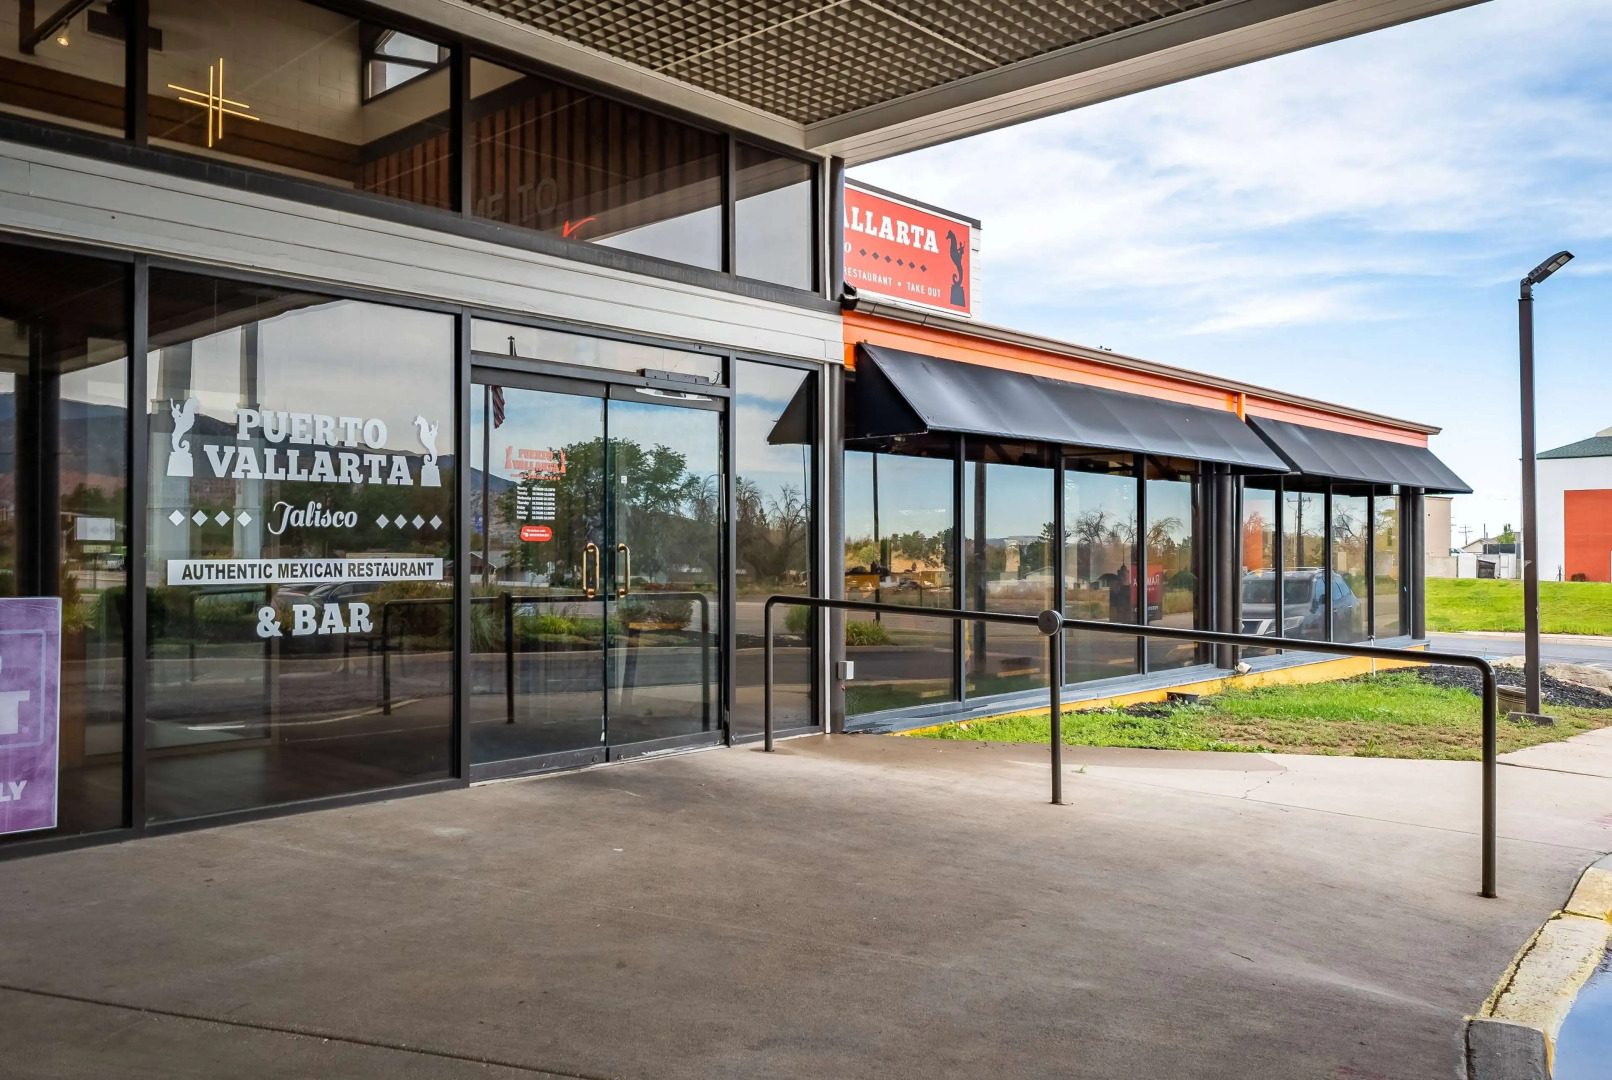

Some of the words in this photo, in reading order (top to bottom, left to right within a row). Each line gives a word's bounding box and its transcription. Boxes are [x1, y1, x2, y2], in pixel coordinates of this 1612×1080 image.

[906, 281, 926, 295] TAKE
[927, 284, 942, 298] OUT
[237, 408, 388, 450] PUERTO
[203, 444, 414, 486] VALLARTA
[267, 500, 358, 535] Jalisco
[181, 562, 273, 581] AUTHENTIC
[277, 562, 343, 579] MEXICAN
[347, 561, 434, 578] RESTAURANT
[256, 606, 283, 638] &
[292, 602, 374, 636] BAR
